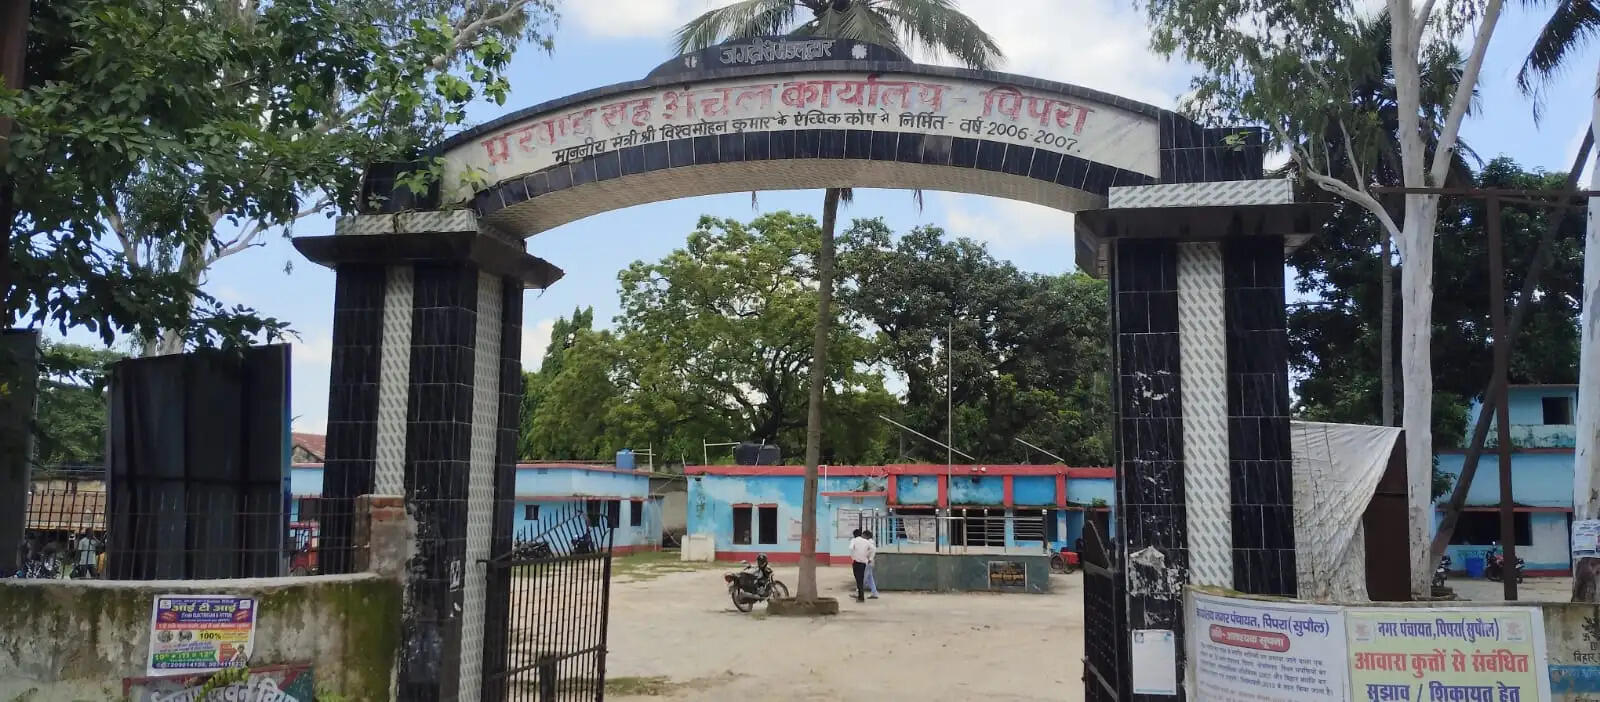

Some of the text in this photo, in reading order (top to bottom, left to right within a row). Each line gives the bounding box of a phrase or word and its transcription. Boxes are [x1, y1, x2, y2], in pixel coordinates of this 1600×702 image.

[600, 96, 656, 127] सह
[662, 83, 777, 119] अंचल
[779, 74, 952, 110] कार्यालय
[979, 86, 1094, 135] पिपरा
[552, 137, 607, 163] माननीय
[611, 129, 639, 148] मंत्री
[640, 125, 656, 142] श्री
[732, 116, 772, 133] कुमार
[200, 632, 222, 640] 100%
[1377, 621, 1397, 637] नगर
[1353, 648, 1529, 678] आवारा कुत्तों से संबंधित
